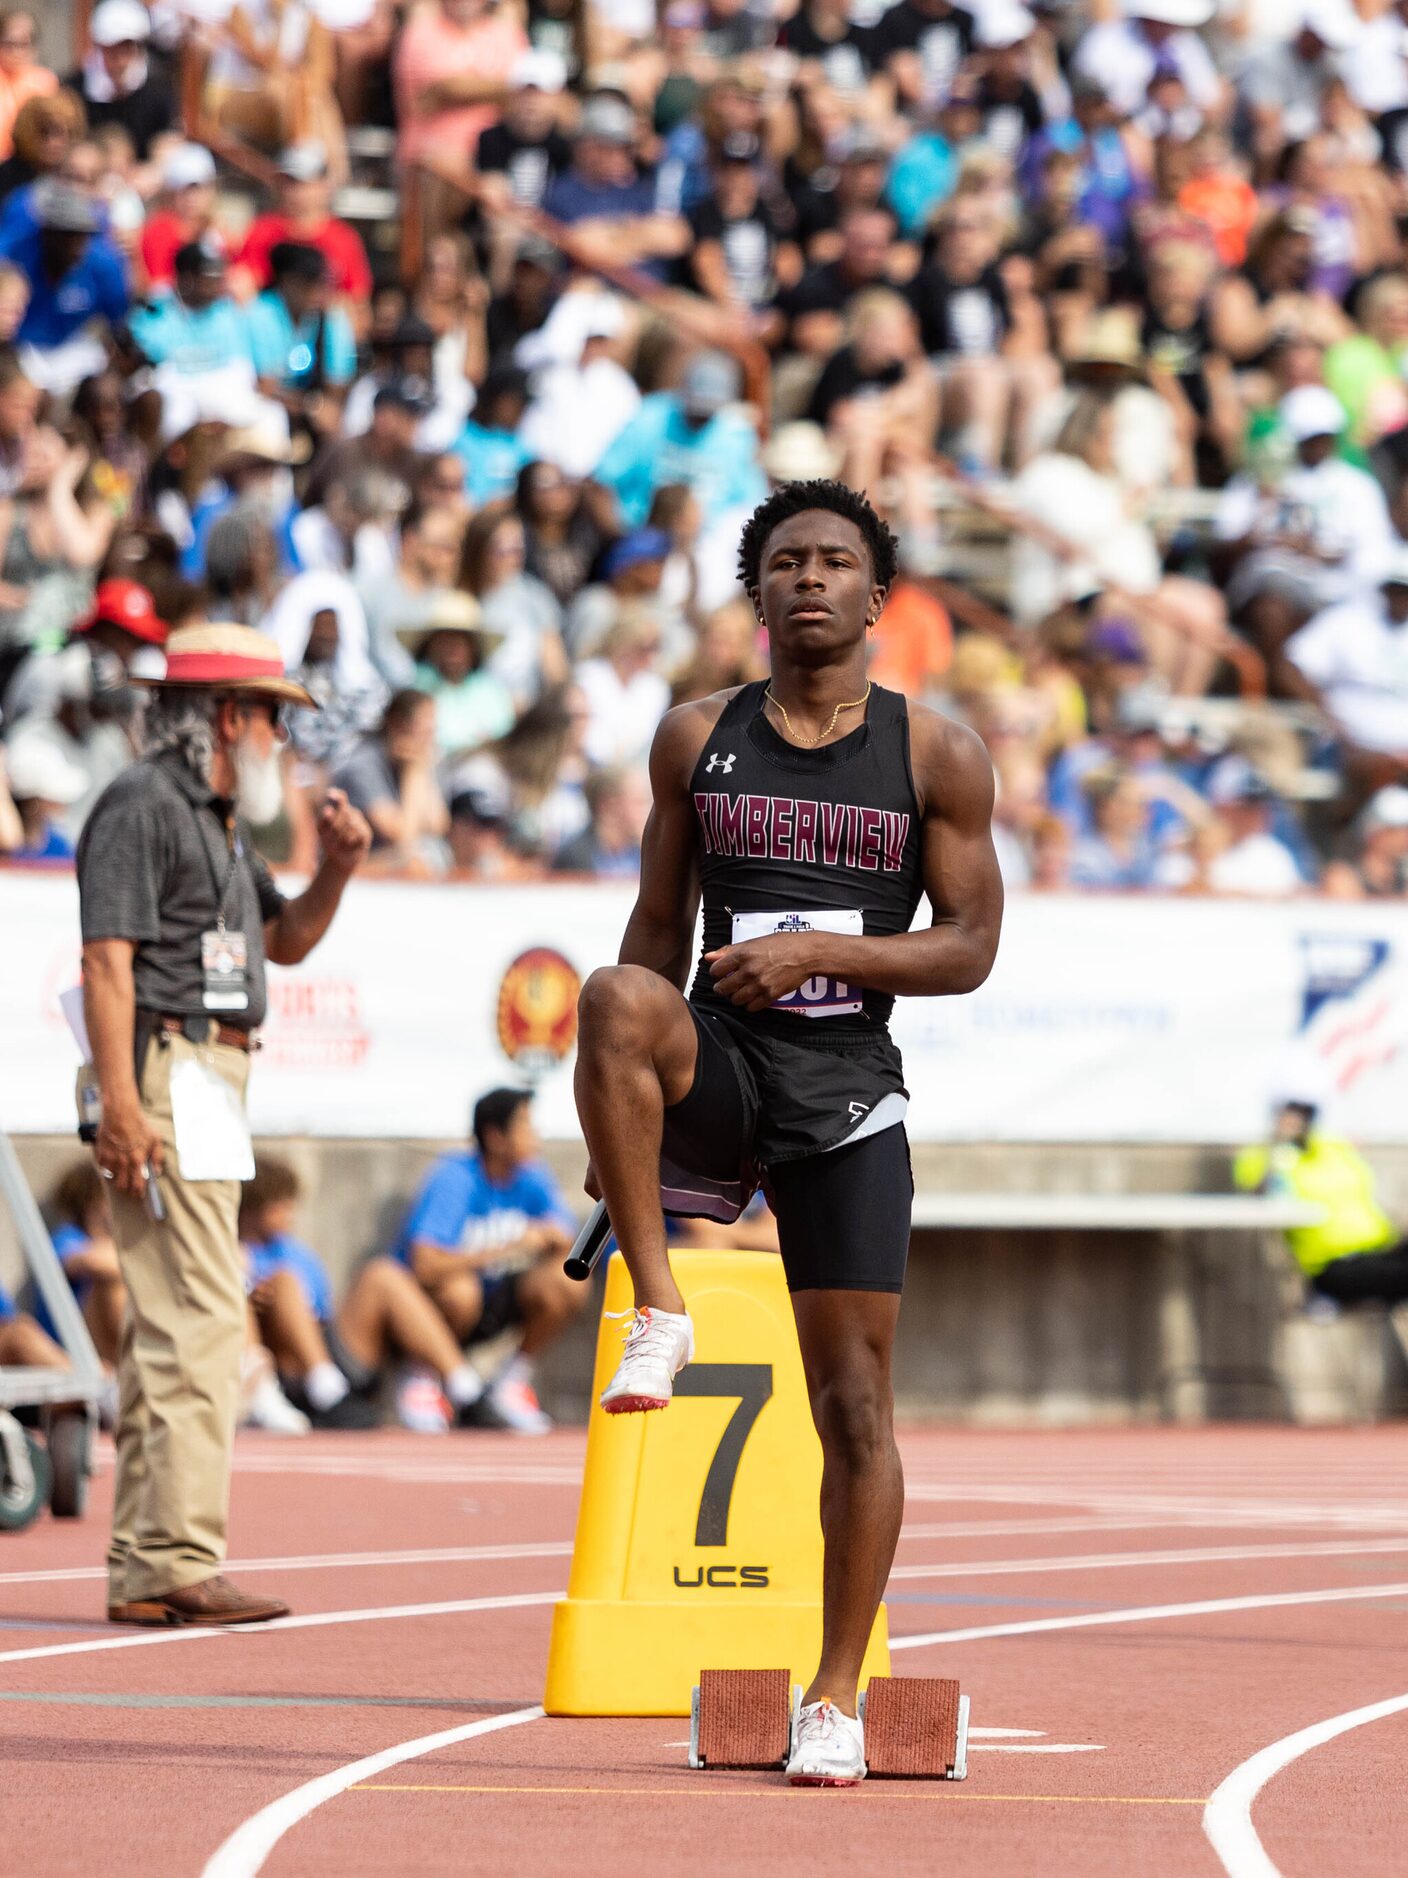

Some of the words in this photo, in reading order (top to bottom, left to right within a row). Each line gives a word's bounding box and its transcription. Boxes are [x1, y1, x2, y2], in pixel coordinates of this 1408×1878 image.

[693, 792, 910, 872] TIMBERVIEW
[672, 1363, 773, 1547] 7
[673, 1566, 770, 1588] UCS
